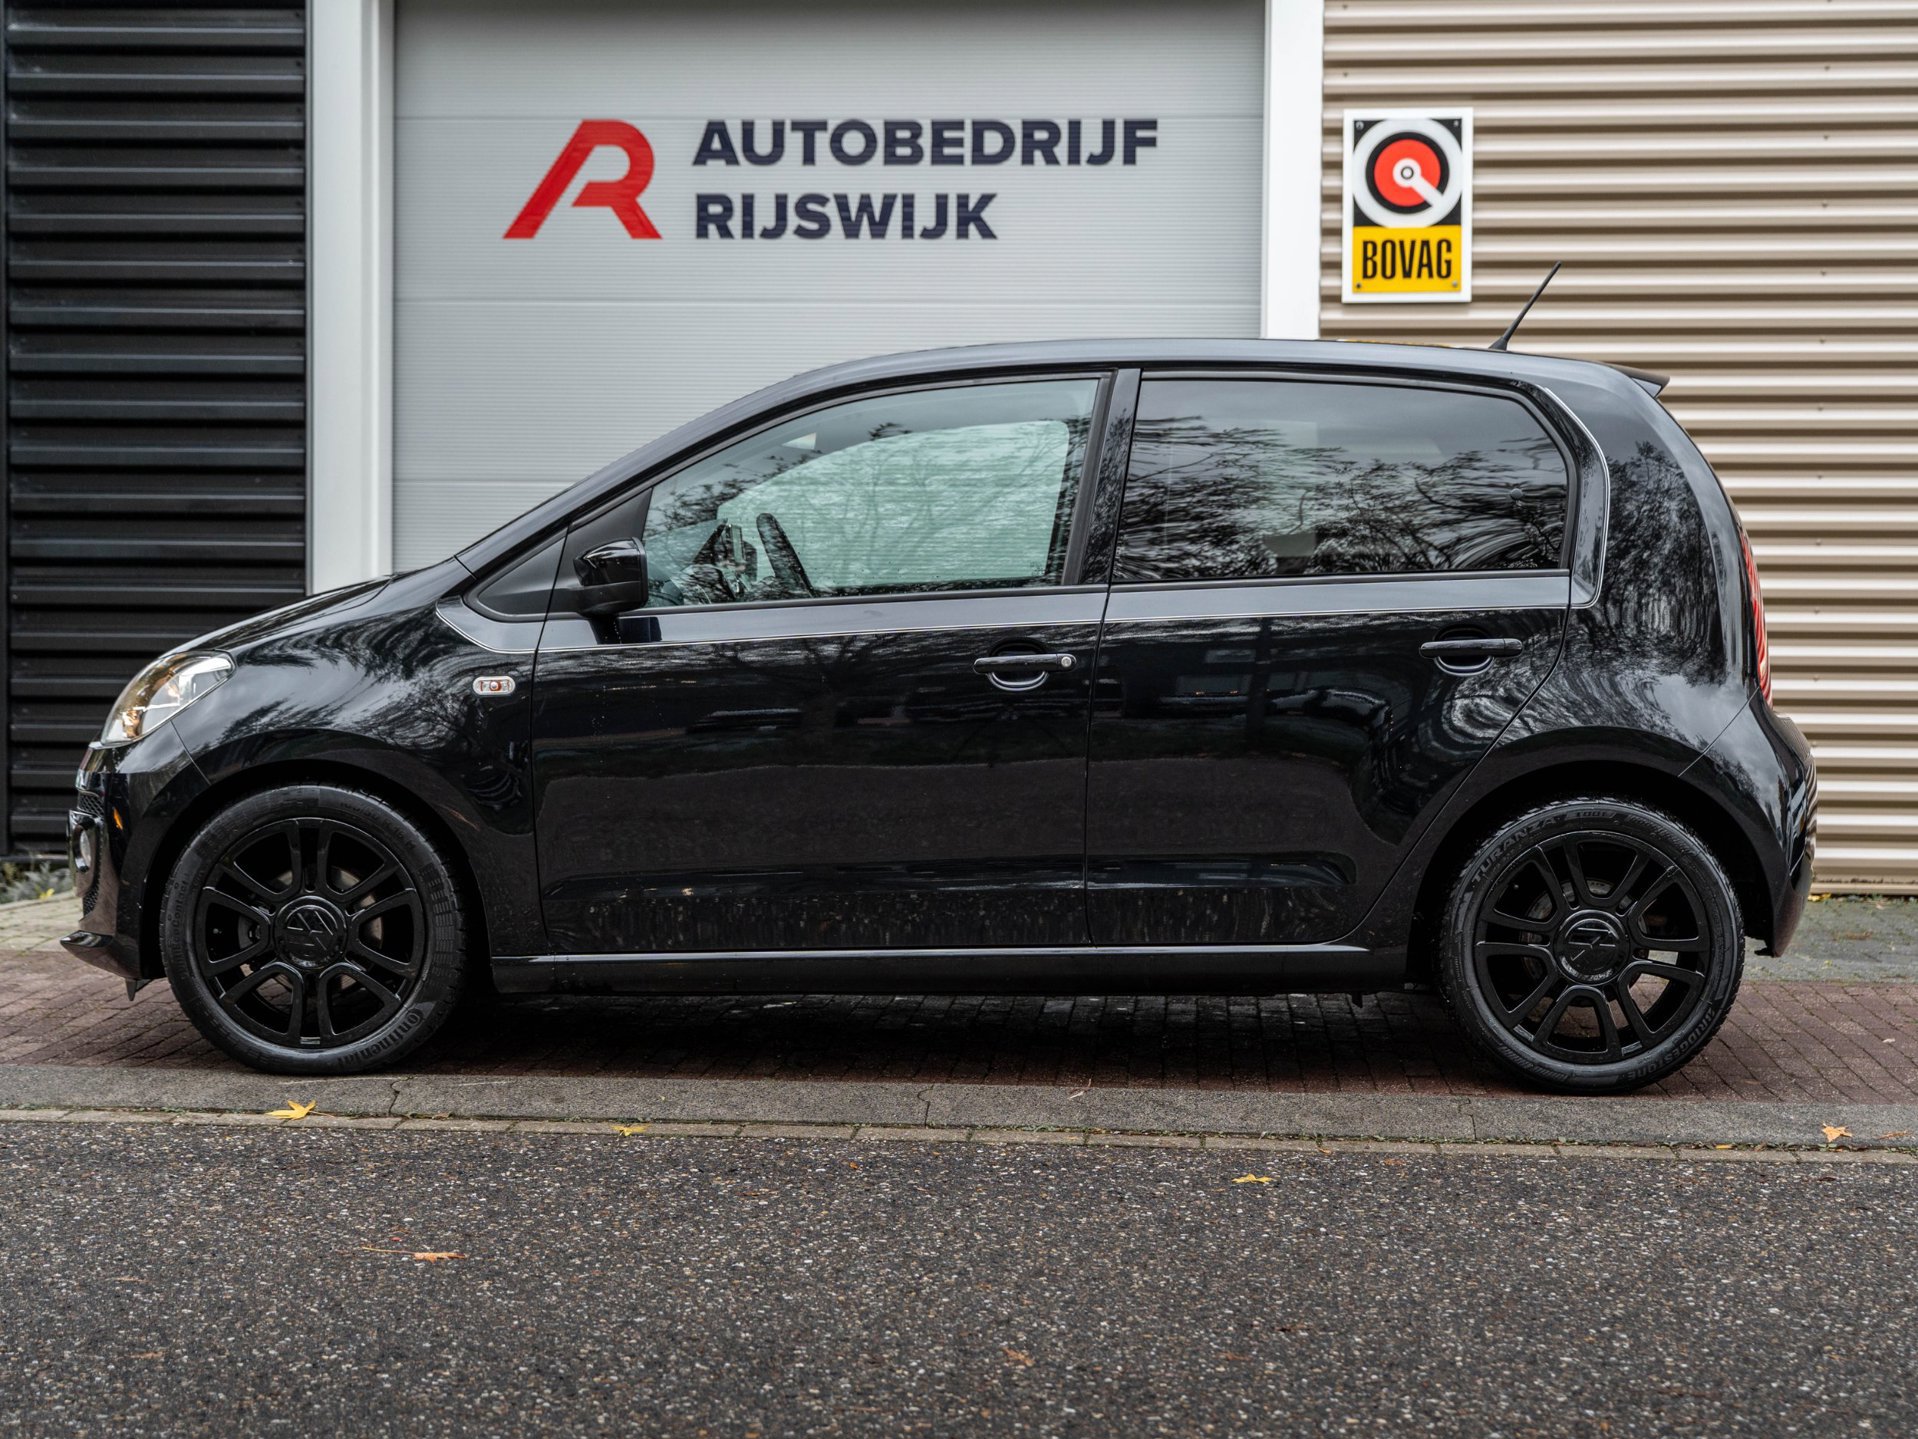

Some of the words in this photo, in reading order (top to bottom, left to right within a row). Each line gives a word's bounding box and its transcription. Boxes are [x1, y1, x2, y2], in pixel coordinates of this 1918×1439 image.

[693, 119, 1157, 166] AUTOBEDRIJF
[696, 194, 997, 239] RIJSWIJK
[1363, 239, 1451, 279] BOVAG
[1471, 815, 1557, 882] TURANZA
